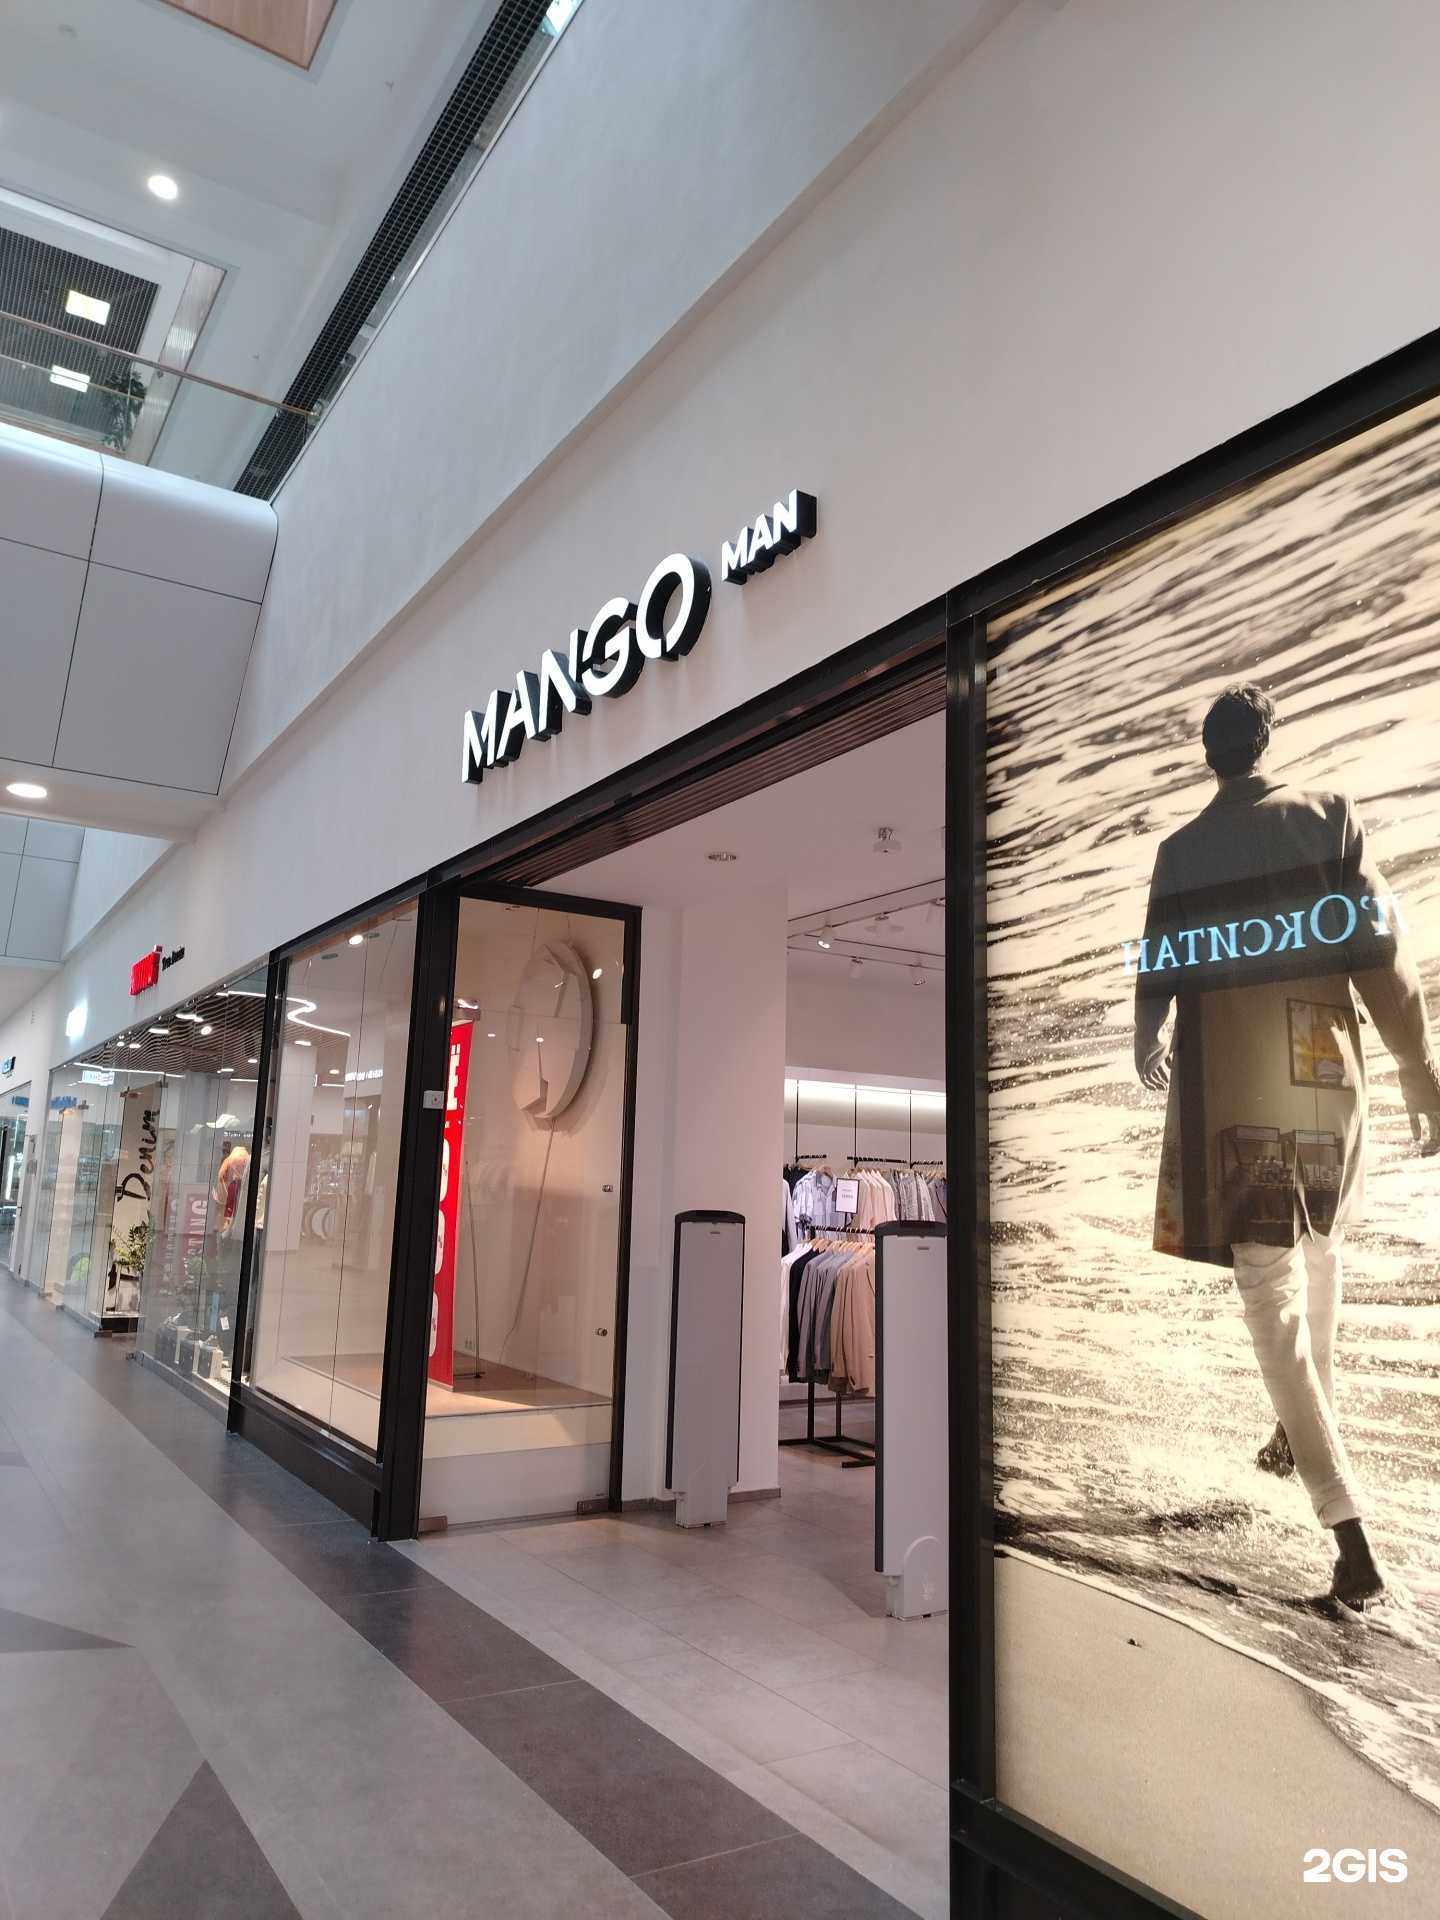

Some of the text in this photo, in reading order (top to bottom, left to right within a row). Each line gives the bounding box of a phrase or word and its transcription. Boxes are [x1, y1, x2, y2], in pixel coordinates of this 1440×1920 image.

[462, 488, 816, 784] MANGO MAN
[116, 1109, 160, 1202] Denim
